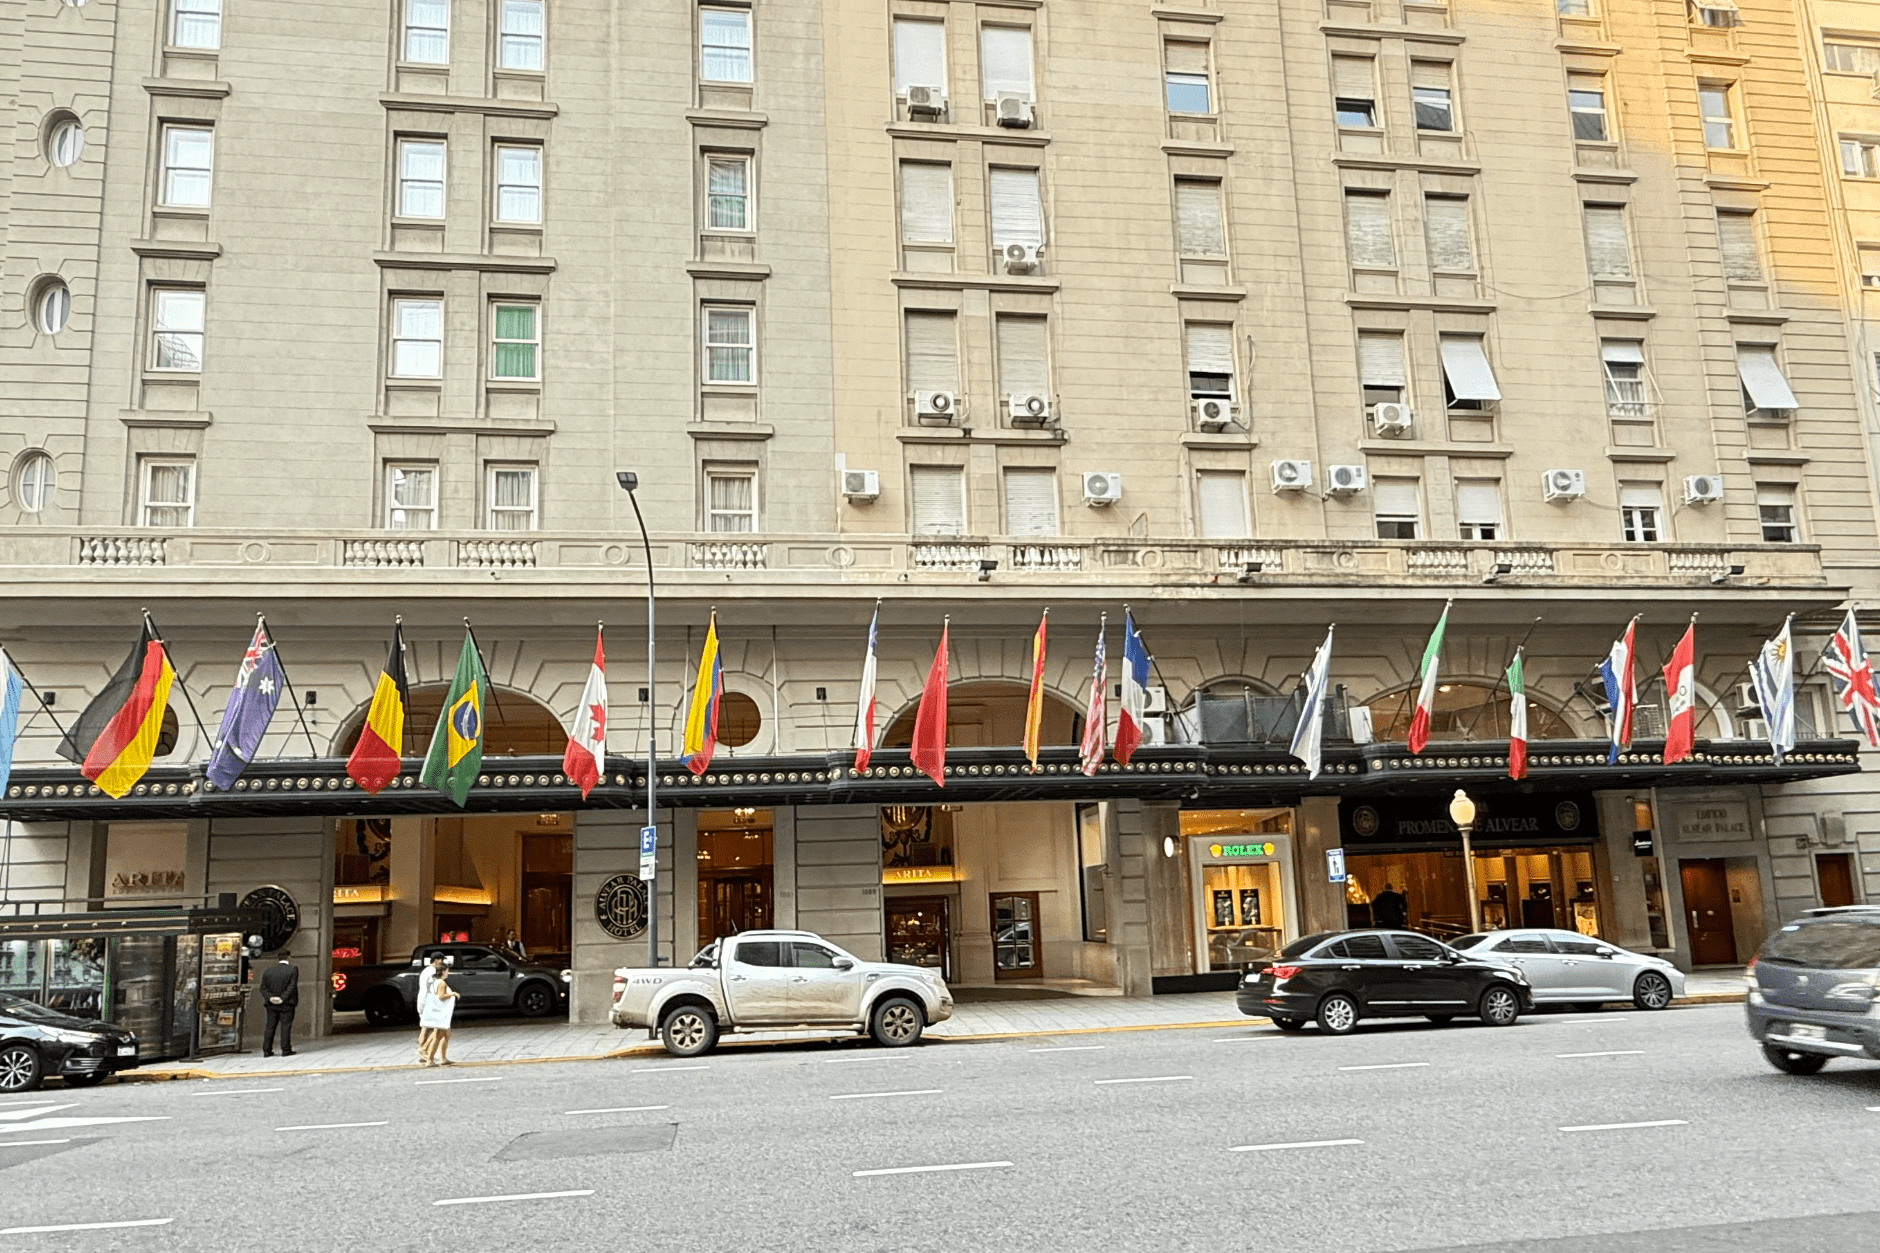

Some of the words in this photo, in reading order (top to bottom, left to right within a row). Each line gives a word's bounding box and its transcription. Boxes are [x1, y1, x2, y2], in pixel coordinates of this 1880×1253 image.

[1398, 818, 1483, 835] PROMENE
[1485, 817, 1539, 833] ALVEAR
[1223, 845, 1264, 856] ROLEX
[112, 871, 186, 888] ARITA
[896, 869, 932, 878] ARITA
[599, 876, 625, 910] ALVEAR
[606, 922, 642, 936] HOTEL
